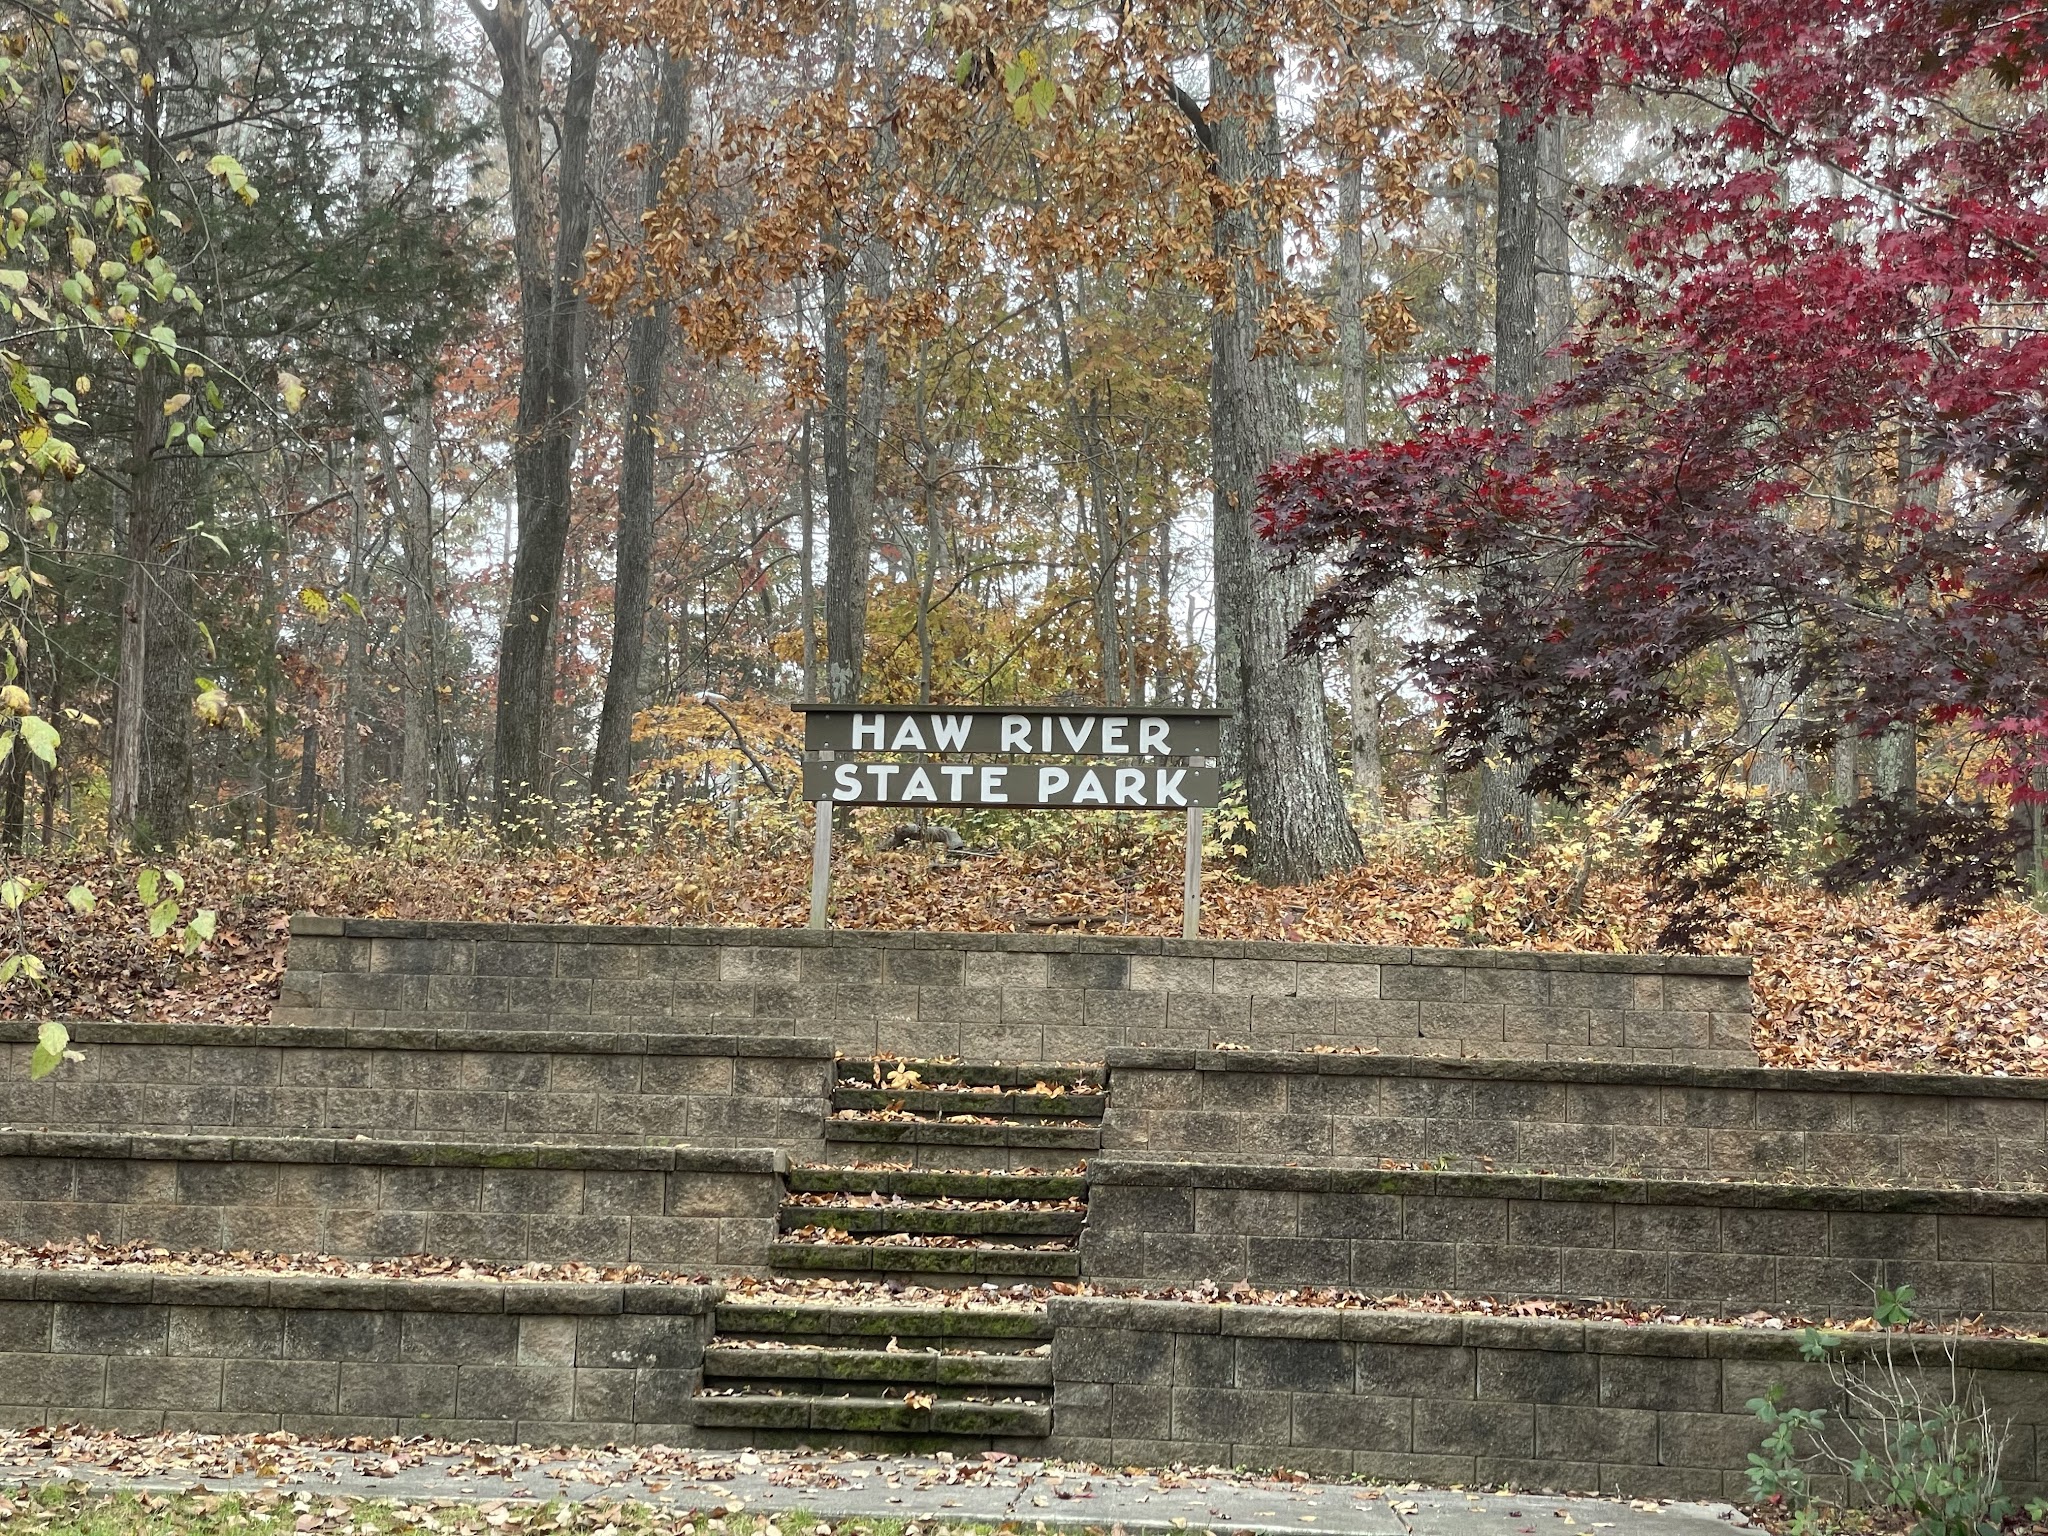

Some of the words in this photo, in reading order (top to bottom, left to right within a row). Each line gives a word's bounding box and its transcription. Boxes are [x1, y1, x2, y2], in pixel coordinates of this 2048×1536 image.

[851, 714, 973, 752] HAW
[1001, 715, 1172, 755] RIVER
[832, 763, 1008, 802] STATE
[1038, 767, 1188, 806] PARK
